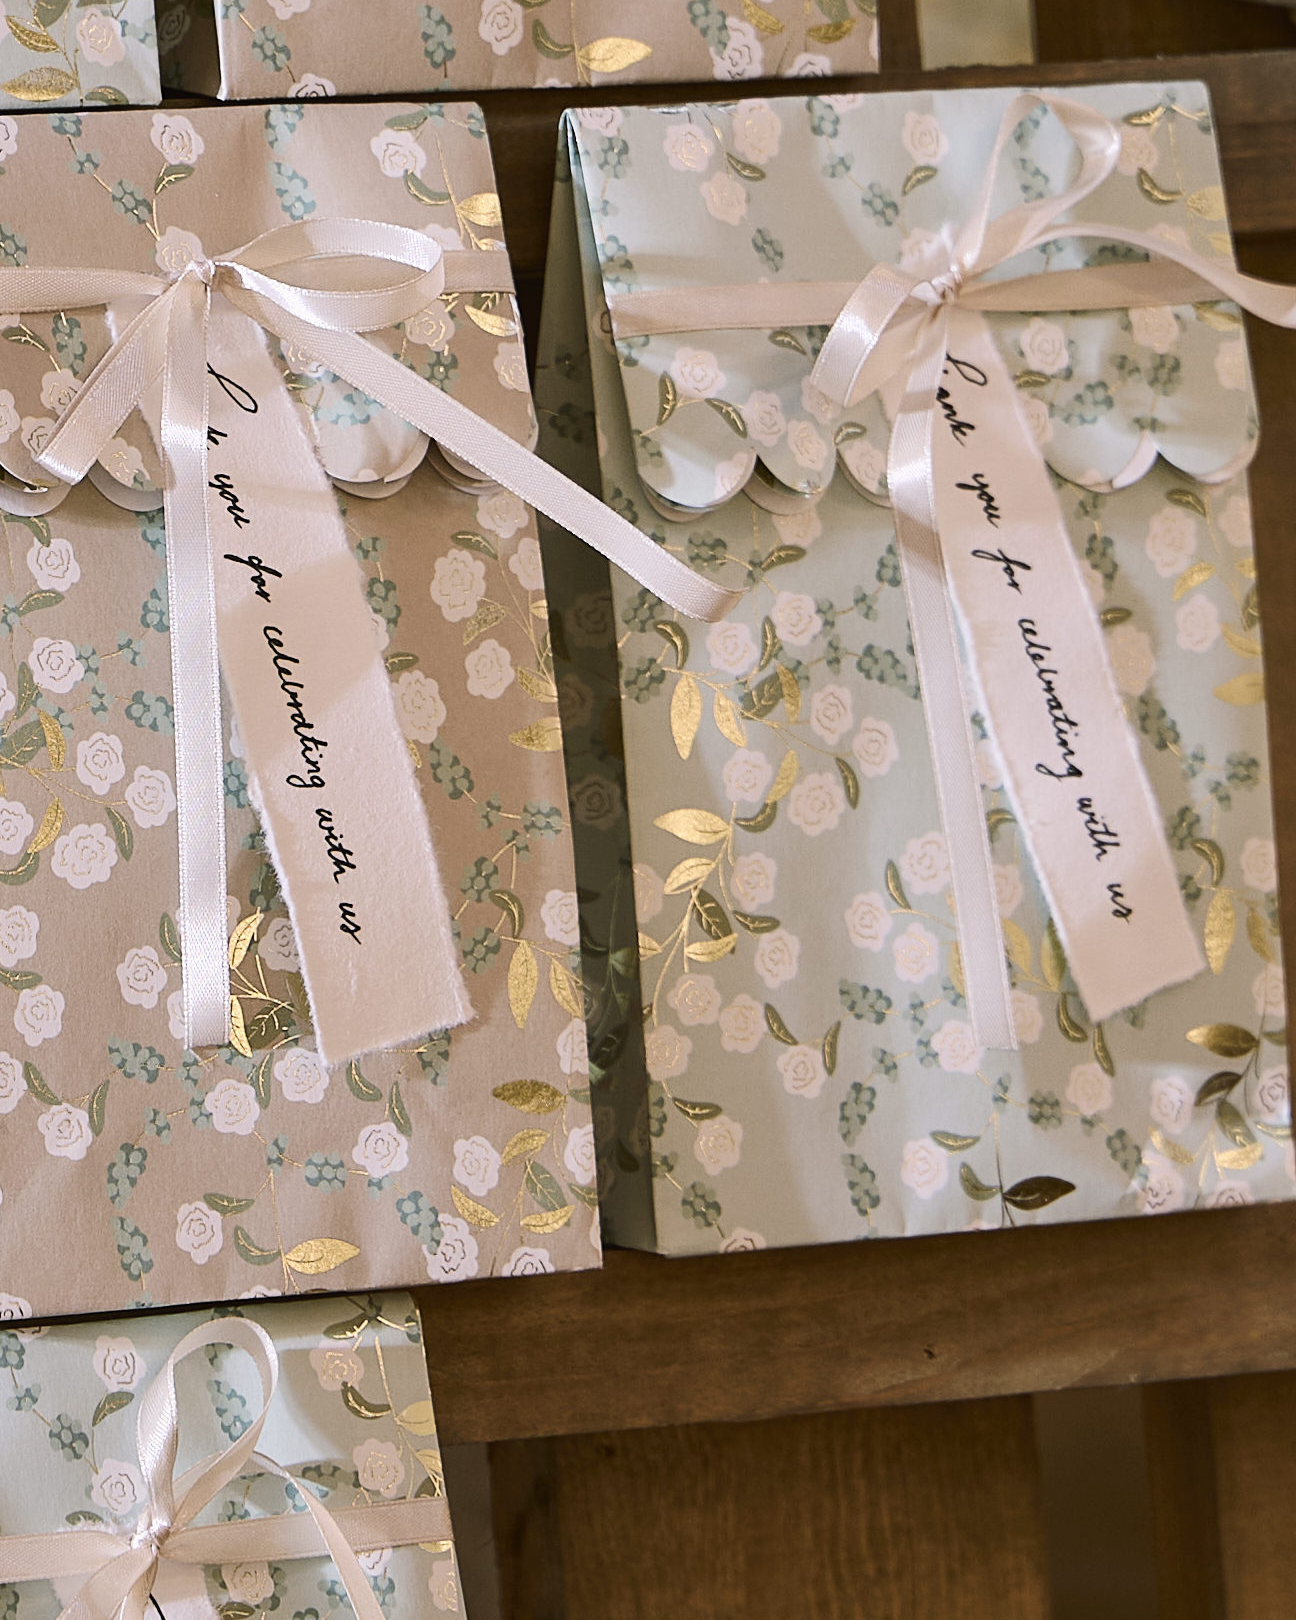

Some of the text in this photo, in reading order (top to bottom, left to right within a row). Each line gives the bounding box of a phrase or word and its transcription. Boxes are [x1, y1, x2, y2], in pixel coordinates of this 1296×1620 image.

[207, 473, 251, 529] you
[955, 473, 1001, 528] you
[223, 553, 283, 604] for
[971, 548, 1032, 594] for
[262, 625, 329, 789] celebrating
[1017, 618, 1083, 780] celebrating
[314, 807, 357, 885] with
[1077, 797, 1121, 861] with
[338, 902, 362, 945] us
[1107, 881, 1133, 924] us
